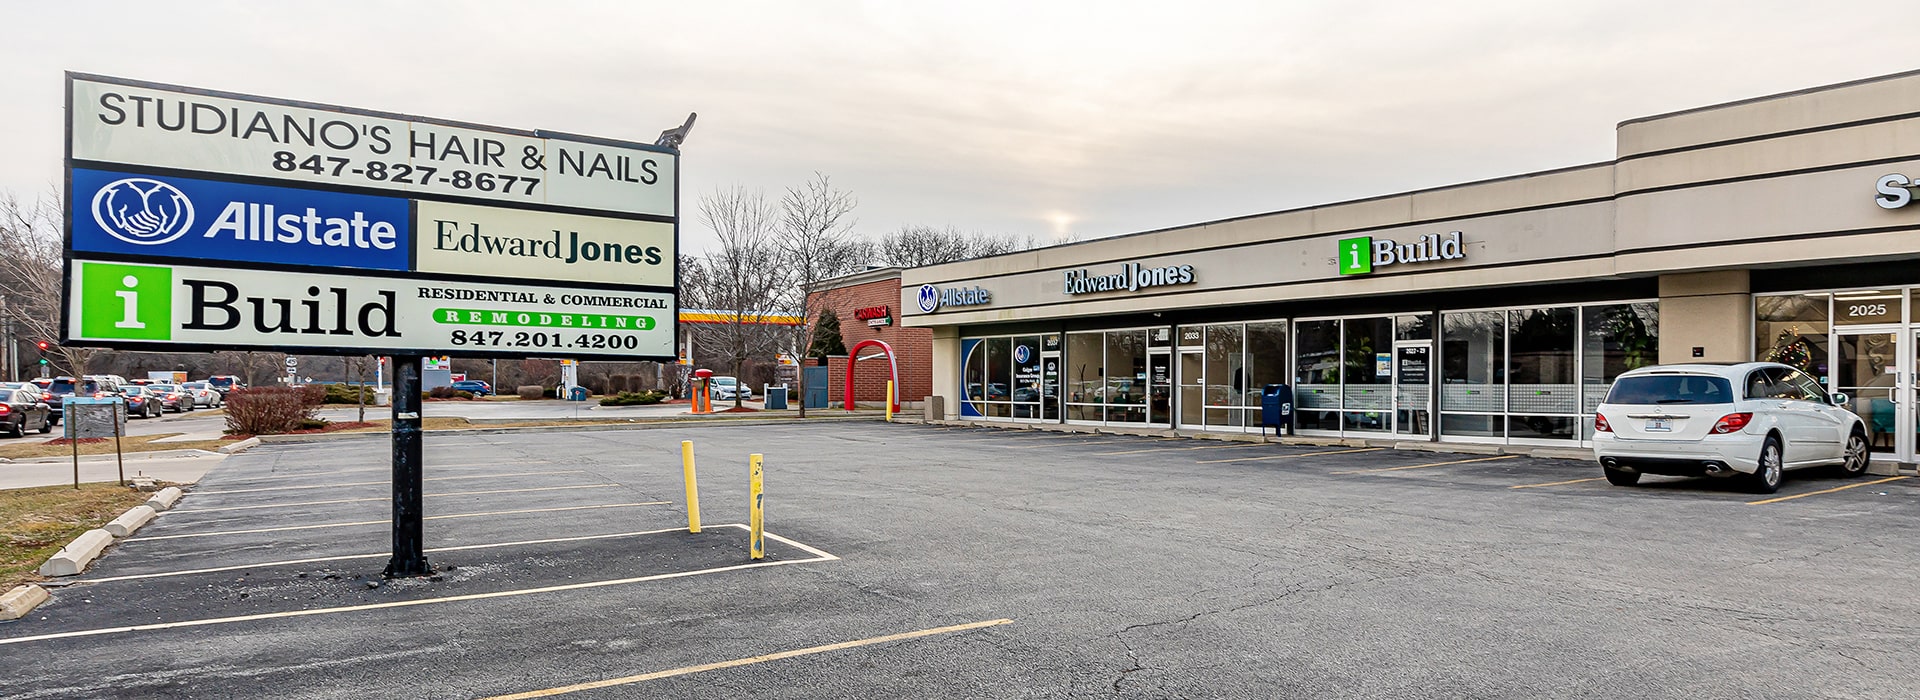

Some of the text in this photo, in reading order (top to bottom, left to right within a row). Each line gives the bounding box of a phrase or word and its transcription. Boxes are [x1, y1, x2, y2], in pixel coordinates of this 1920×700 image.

[98, 92, 659, 185] STUDIANO'S HAIR & NAILS
[272, 151, 541, 197] 847-827-8677
[1875, 173, 1920, 210] S
[203, 201, 397, 250] Allstate
[1372, 231, 1465, 267] Build
[115, 275, 402, 338] i Build
[417, 287, 667, 309] RESIDENTIAL & COMMERCIAL
[940, 286, 988, 307] Allstate
[1849, 304, 1887, 316] 2025
[446, 310, 647, 329] REMODELING
[450, 330, 638, 349] 847.201.4200
[1184, 331, 1200, 340] 2033
